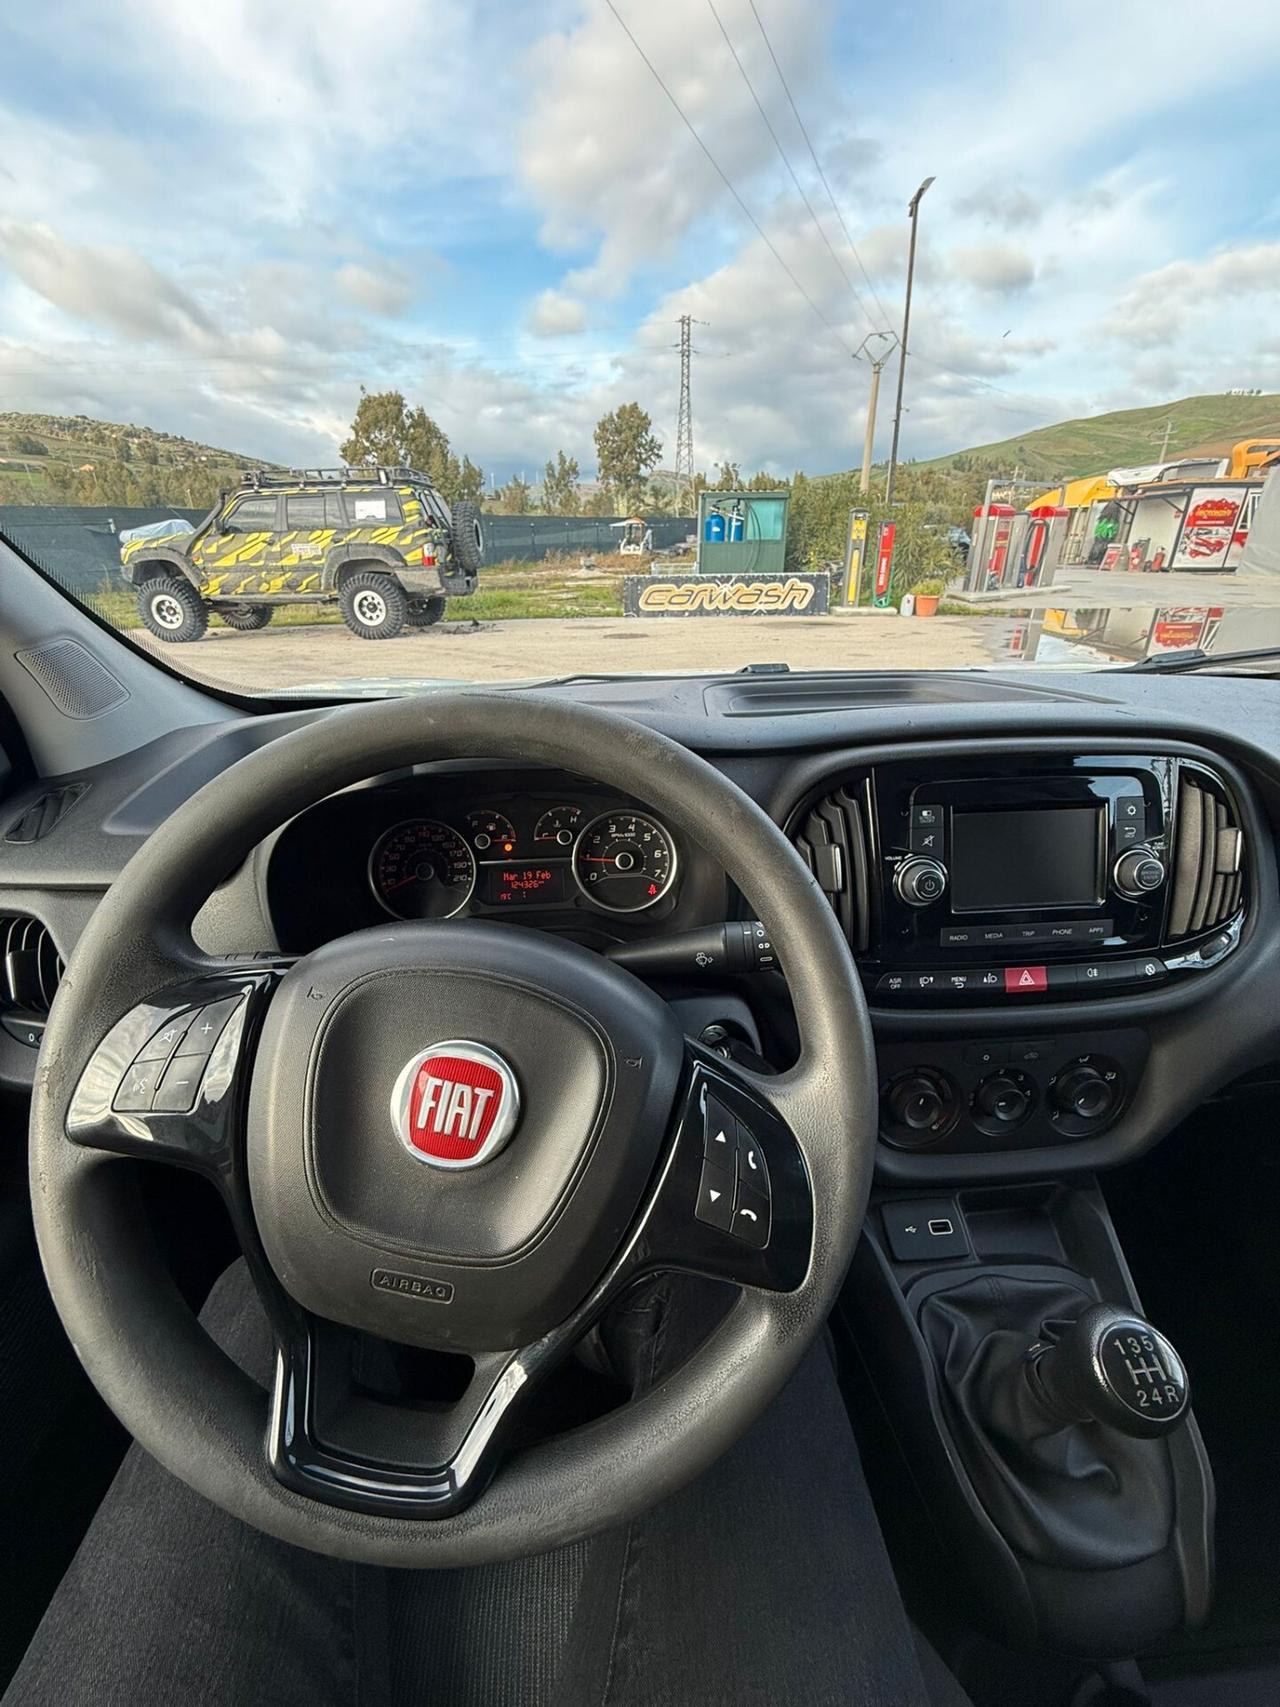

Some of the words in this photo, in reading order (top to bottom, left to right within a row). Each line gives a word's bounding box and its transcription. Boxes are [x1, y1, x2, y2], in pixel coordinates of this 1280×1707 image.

[608, 824, 616, 833] 3
[628, 823, 635, 832] 4
[592, 835, 601, 844] 2
[643, 833, 651, 841] 5
[654, 849, 661, 858] 6
[503, 872, 519, 881] Mar
[523, 871, 532, 880] 19
[536, 870, 552, 880] Feb
[589, 872, 597, 881] 0
[654, 869, 661, 877] 7
[1088, 926, 1104, 934] APPS
[951, 975, 967, 983] MENU
[416, 1076, 495, 1141] FIAT
[379, 1274, 447, 1298] AIRBAG
[1113, 1338, 1126, 1355] 1
[1126, 1336, 1141, 1354] 3
[1140, 1335, 1154, 1351] 5
[1136, 1390, 1150, 1407] 2
[1152, 1388, 1163, 1405] 4
[1164, 1385, 1180, 1403] R
